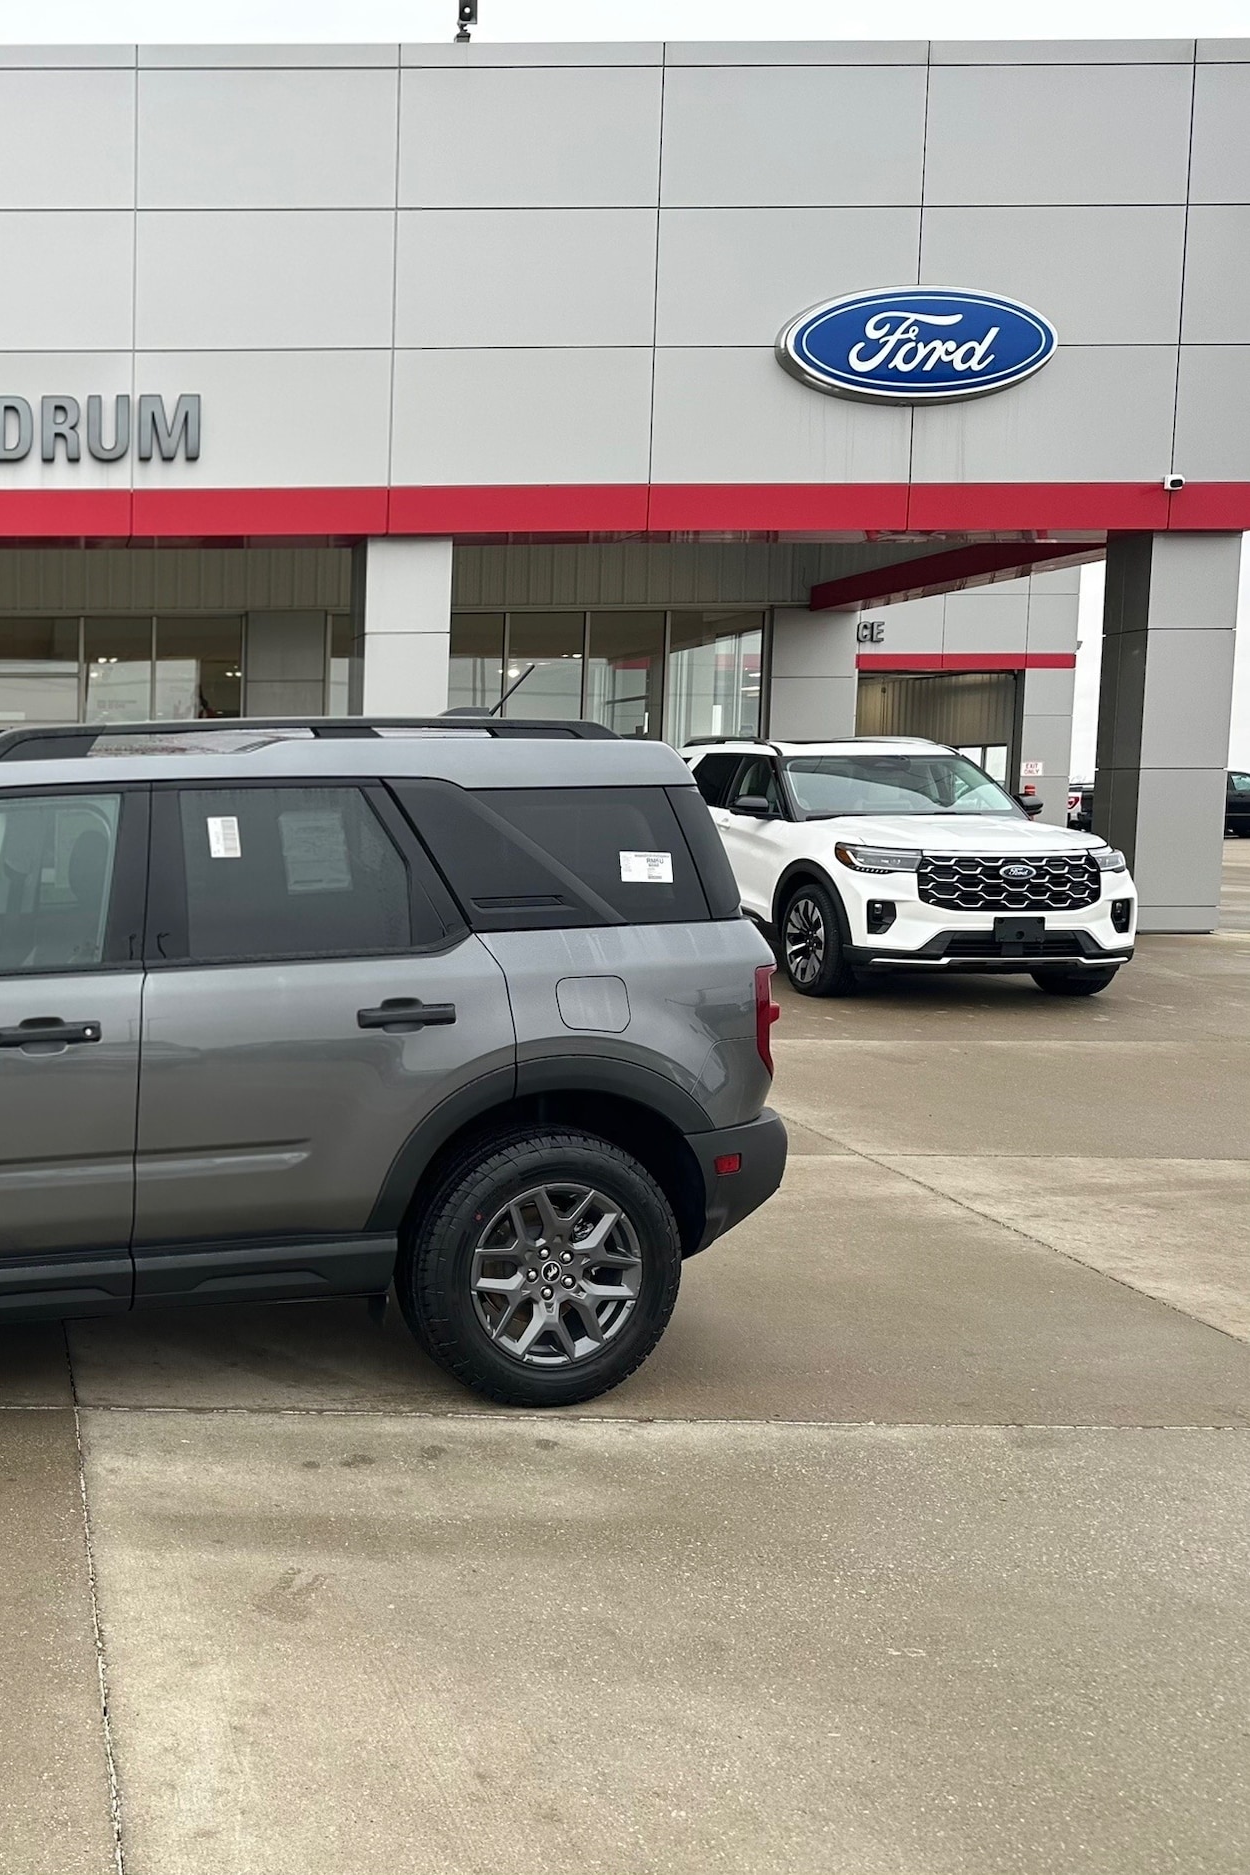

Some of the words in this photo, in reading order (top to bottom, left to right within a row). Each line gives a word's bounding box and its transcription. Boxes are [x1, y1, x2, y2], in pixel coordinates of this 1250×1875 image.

[848, 311, 1000, 372] Ford
[857, 621, 885, 643] CE
[1008, 867, 1029, 876] Ford
